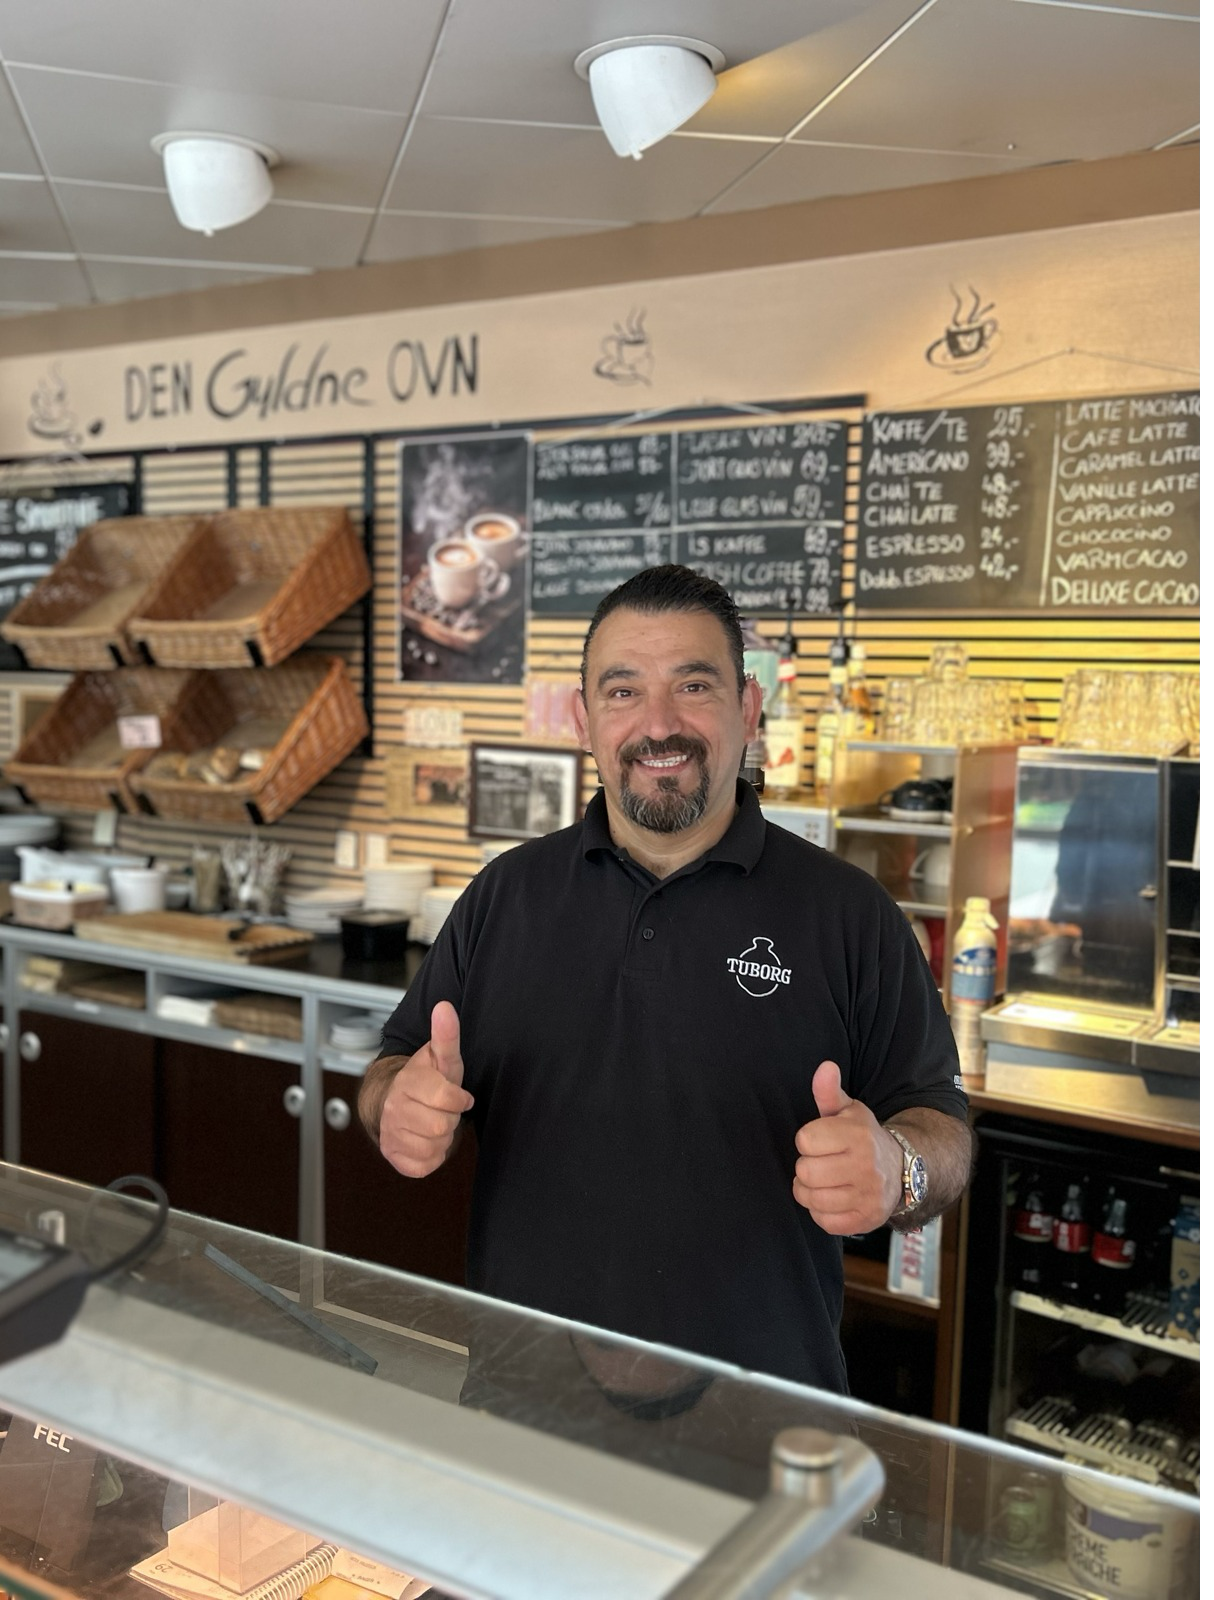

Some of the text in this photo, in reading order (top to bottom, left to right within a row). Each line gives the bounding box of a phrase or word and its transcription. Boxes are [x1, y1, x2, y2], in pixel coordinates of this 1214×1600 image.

[125, 334, 479, 422] DEN Gyldne OVN
[1065, 400, 1124, 426] LATTE
[1062, 421, 1188, 453] CAFE LATTE
[867, 448, 969, 476] AMERICANO
[1059, 451, 1145, 479] CARAMEL
[913, 481, 943, 501] TE
[1141, 472, 1199, 496] LATTE
[865, 533, 965, 559] ESPRESSO
[1122, 549, 1188, 569] CACAO
[1051, 576, 1199, 605] DELUXE CACAO
[727, 957, 792, 984] TUBORG
